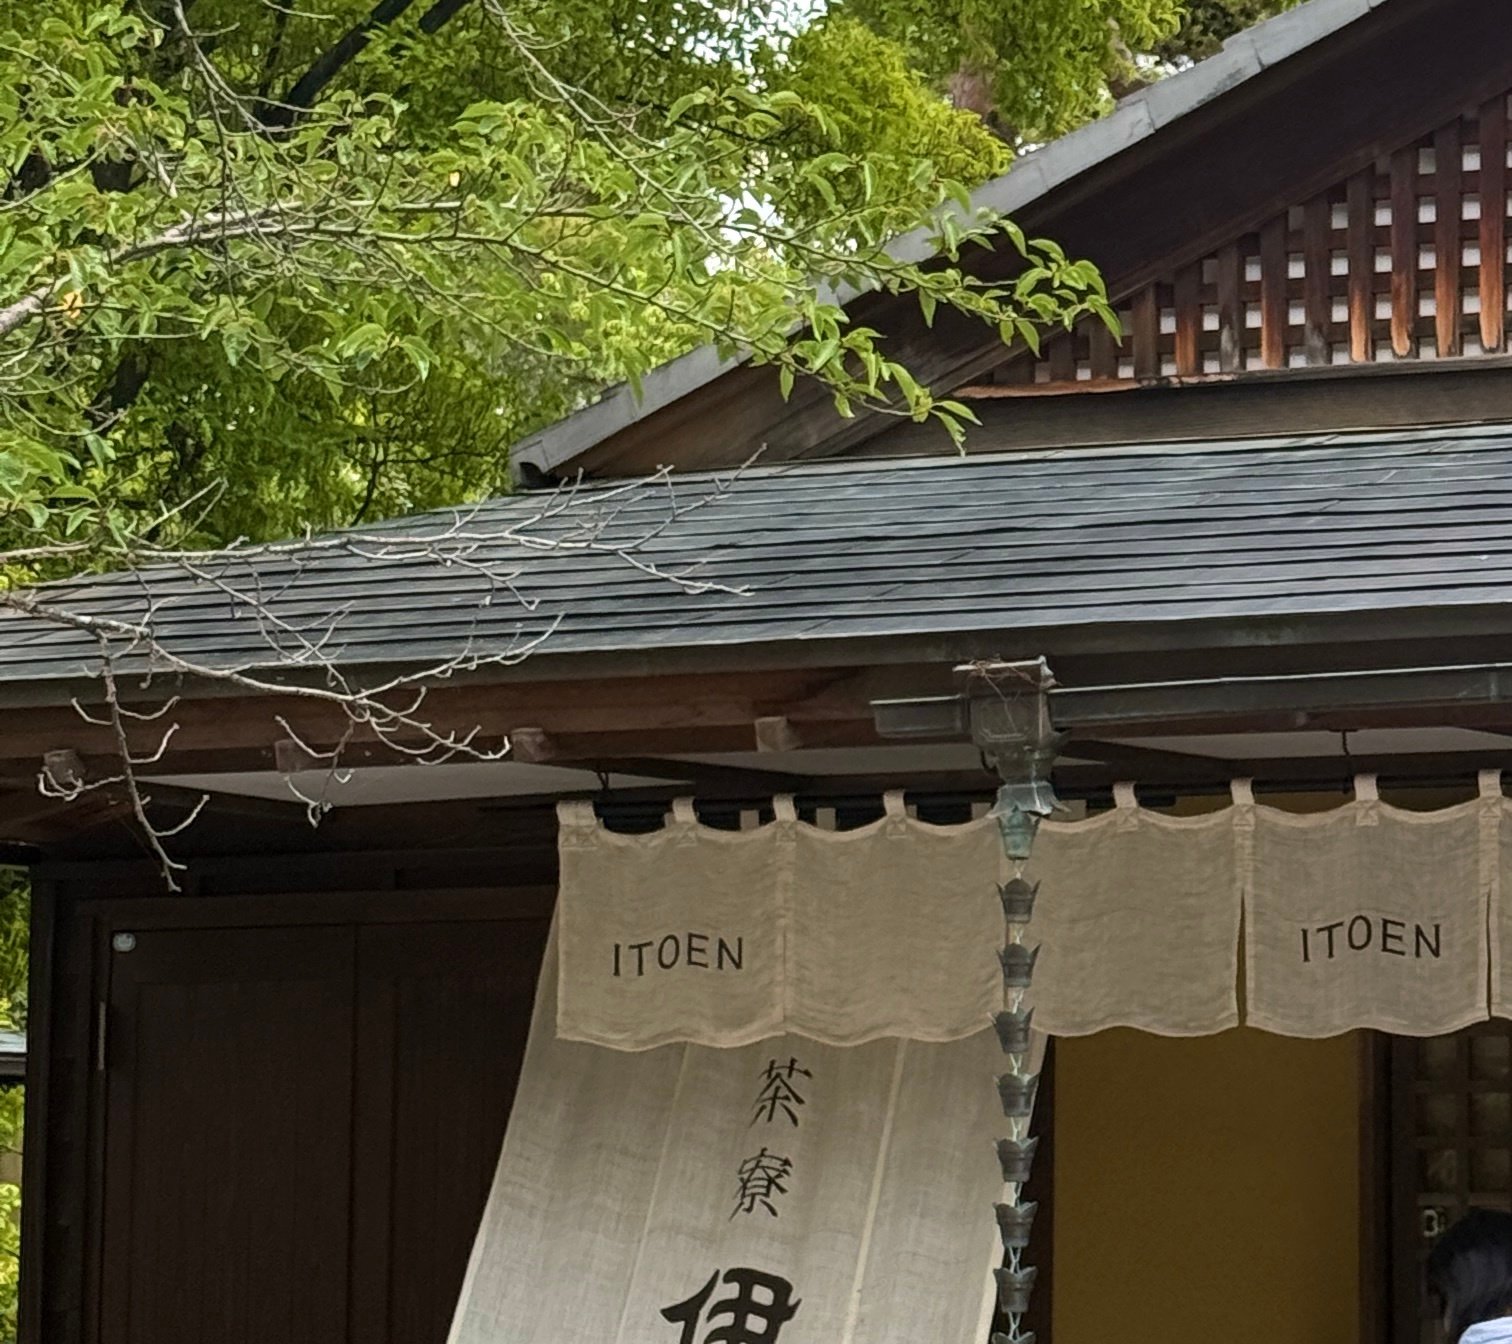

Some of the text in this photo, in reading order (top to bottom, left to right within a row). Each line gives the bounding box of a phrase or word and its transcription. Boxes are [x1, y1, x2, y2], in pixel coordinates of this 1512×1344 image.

[613, 932, 744, 978] ITOEN
[1300, 913, 1442, 963] ITOEN
[728, 1056, 814, 1220] 茶寮
